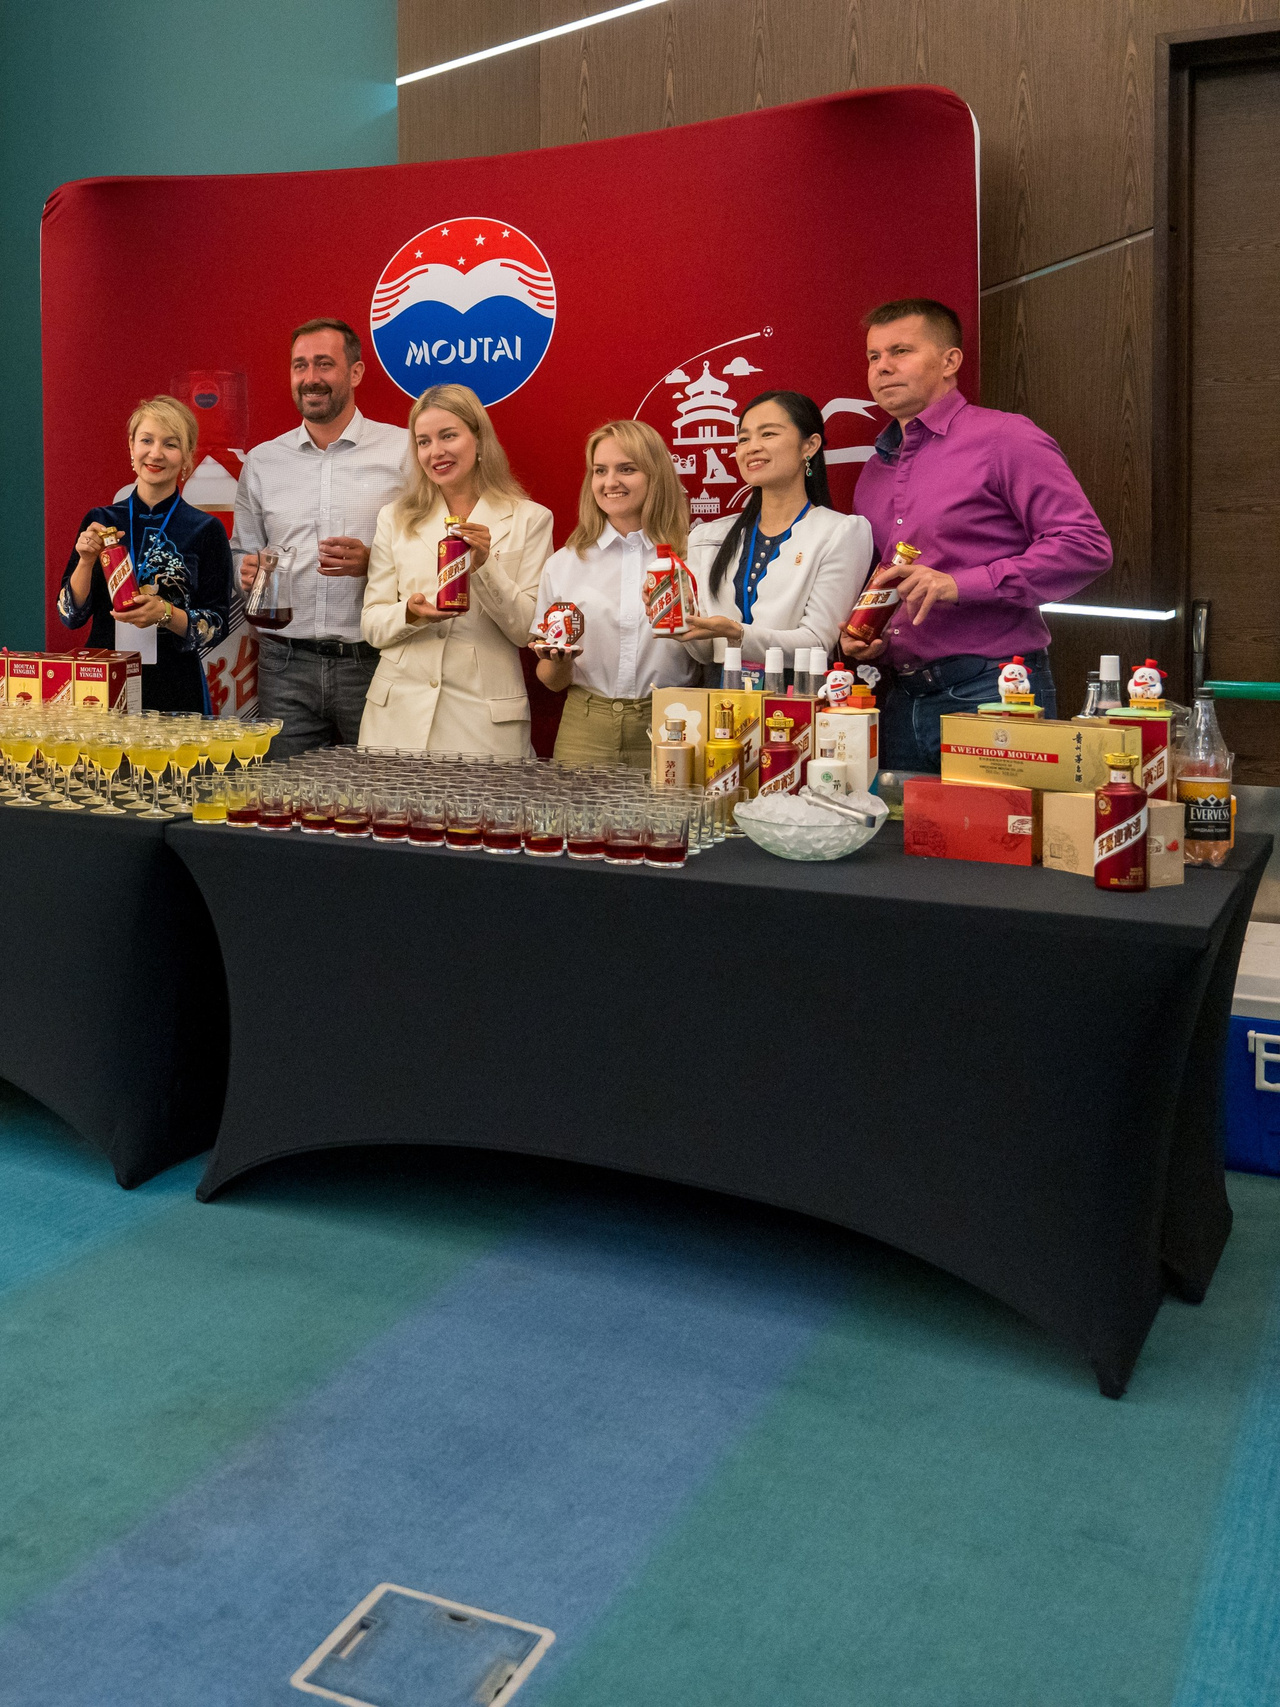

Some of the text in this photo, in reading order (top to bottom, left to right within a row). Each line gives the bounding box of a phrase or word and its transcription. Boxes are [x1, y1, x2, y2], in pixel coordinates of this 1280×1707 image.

[405, 335, 521, 367] MOUTAI
[950, 745, 1006, 758] KWEICHOW
[1007, 750, 1048, 762] MOUTAI
[1190, 807, 1230, 821] EVERVESS
